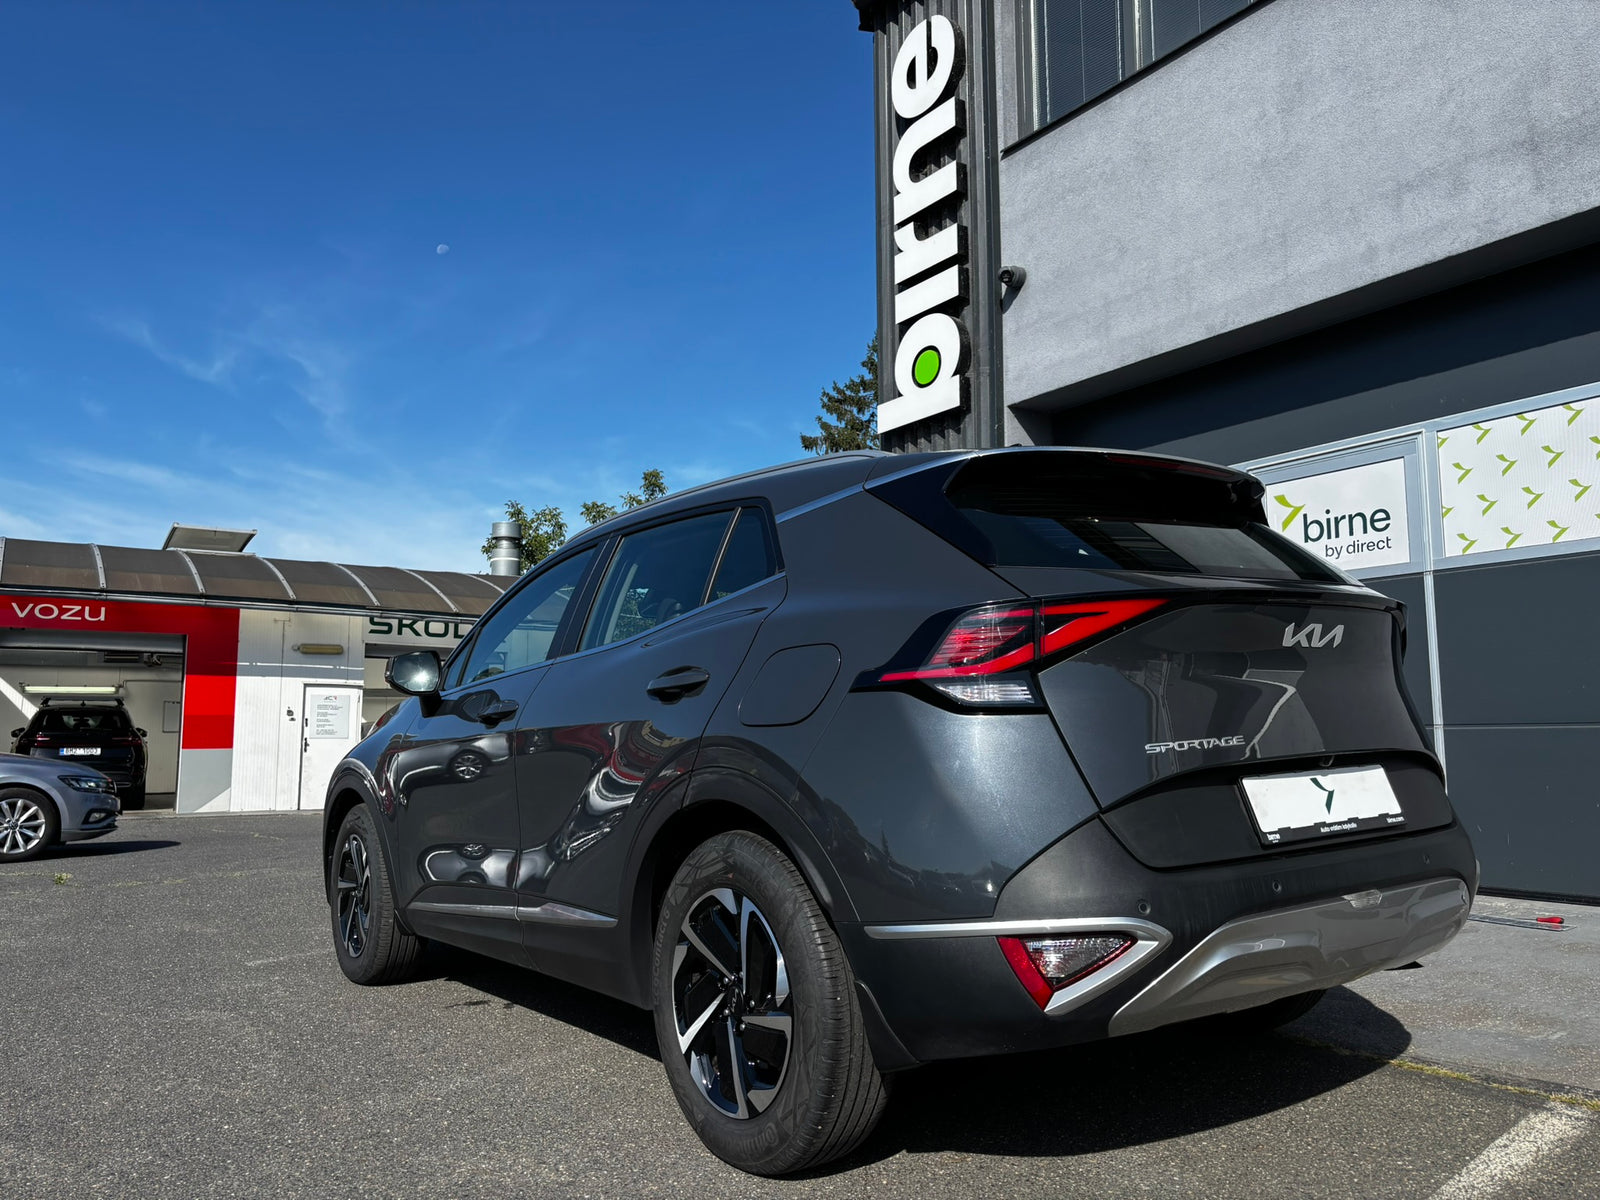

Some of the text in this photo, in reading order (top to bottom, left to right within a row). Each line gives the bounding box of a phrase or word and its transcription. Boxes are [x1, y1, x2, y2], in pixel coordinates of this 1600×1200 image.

[877, 14, 961, 435] birne
[1302, 508, 1391, 543] birne
[1325, 536, 1392, 560] by direct
[1282, 622, 1345, 649] KIA
[1144, 735, 1246, 754] SPORTAGE
